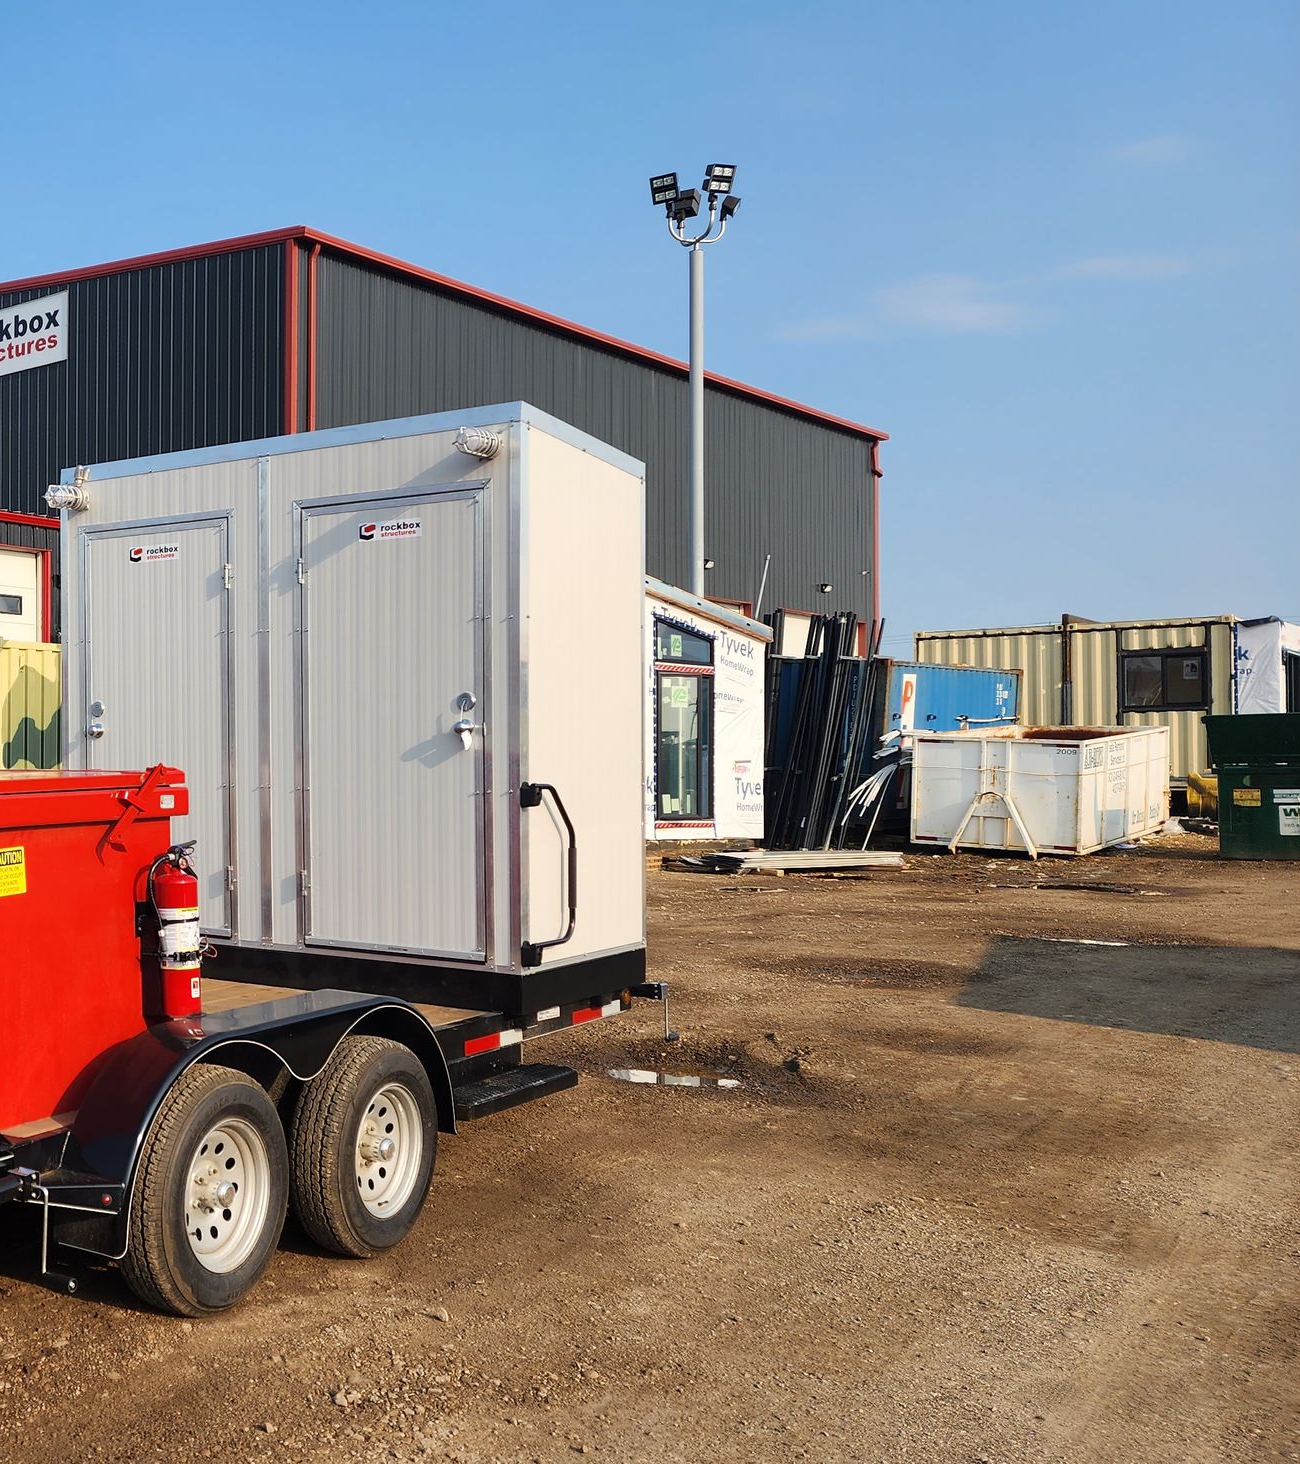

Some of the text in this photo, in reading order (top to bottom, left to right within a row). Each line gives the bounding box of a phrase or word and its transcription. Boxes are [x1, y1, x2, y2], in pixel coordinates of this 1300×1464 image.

[380, 522, 420, 531] rockbox
[146, 546, 178, 554] rockbox
[720, 630, 754, 660] Tyvek
[720, 656, 754, 677] HomeWrap
[734, 778, 763, 800] Tyve
[736, 803, 763, 812] HomeWr
